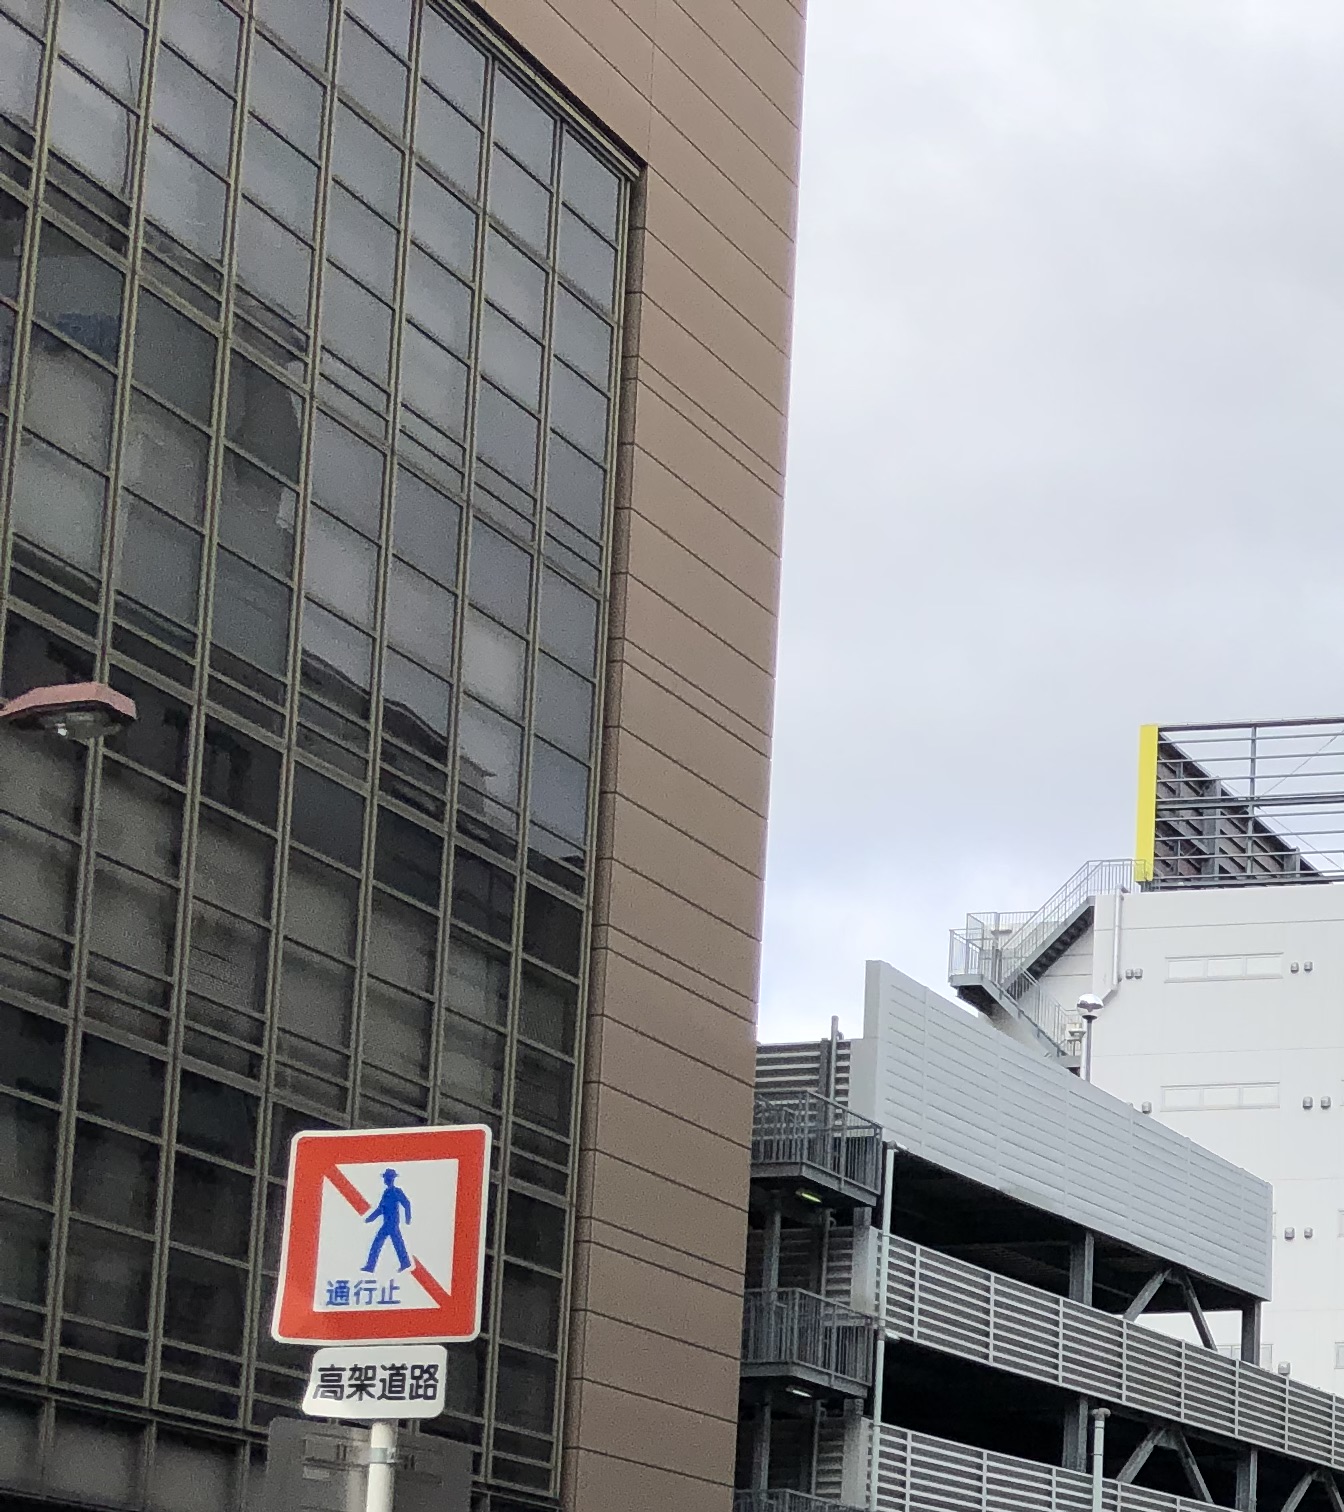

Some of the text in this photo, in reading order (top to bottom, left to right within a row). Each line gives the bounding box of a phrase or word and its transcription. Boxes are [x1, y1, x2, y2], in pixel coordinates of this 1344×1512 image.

[325, 1279, 401, 1306] 通行止
[312, 1362, 440, 1401] 高架道路
